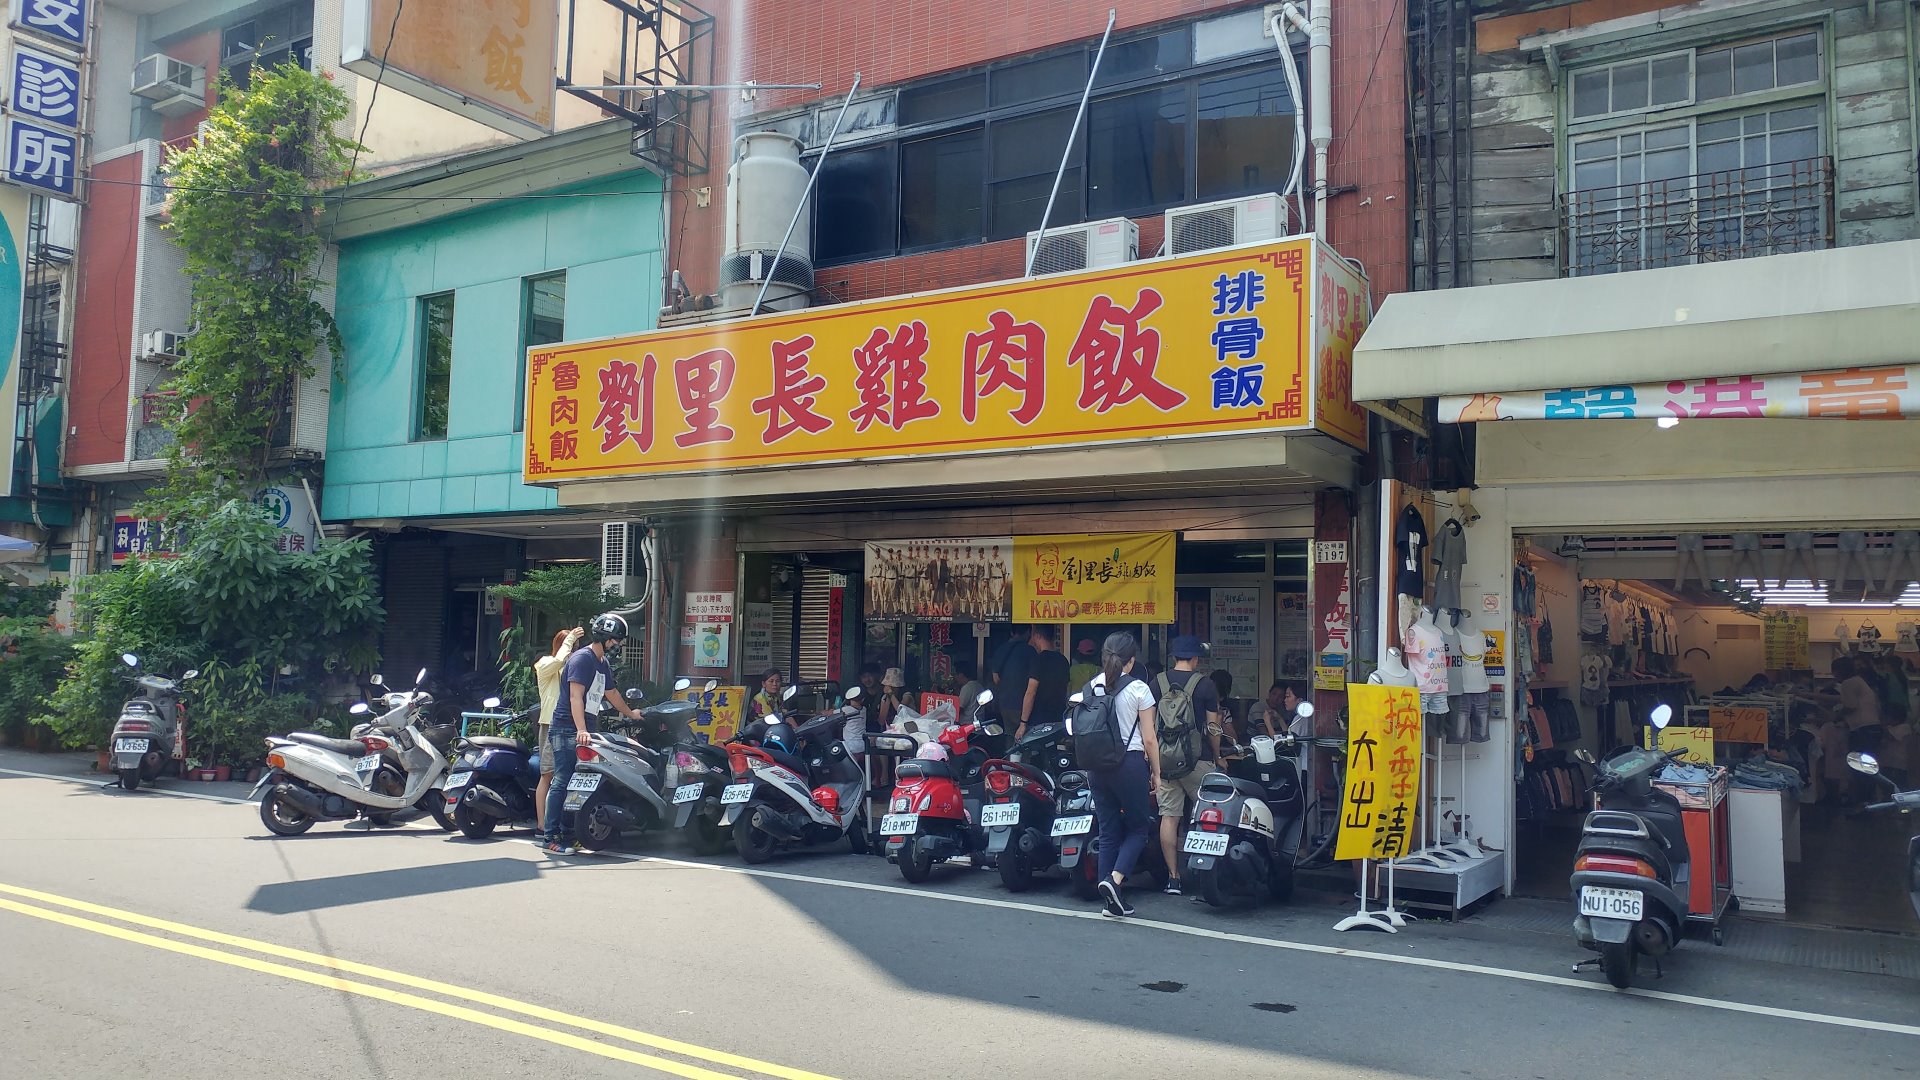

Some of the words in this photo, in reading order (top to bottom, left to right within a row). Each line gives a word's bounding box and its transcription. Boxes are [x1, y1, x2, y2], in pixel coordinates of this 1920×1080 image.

[481, 0, 534, 104] 飯
[14, 0, 79, 188] 安診所
[1320, 271, 1364, 348] 劉里長
[1211, 267, 1265, 412] 排骨飯
[590, 286, 1188, 455] 劉里長雞肉飯
[549, 360, 580, 462] 魯肉飯
[1325, 551, 1345, 561] 197
[835, 579, 846, 587] 195
[917, 600, 953, 617] KANO
[1030, 599, 1079, 619] KANO
[1081, 601, 1156, 616] 電影聯名推薦
[929, 622, 953, 692] 雞肉
[116, 743, 147, 751] LV3-655
[722, 789, 751, 801] 335-PAE
[982, 810, 1018, 823] 261-PHP
[881, 820, 917, 832] 218-MPT
[1052, 819, 1090, 833] MLT-1717
[1187, 837, 1227, 852] 727-HAF
